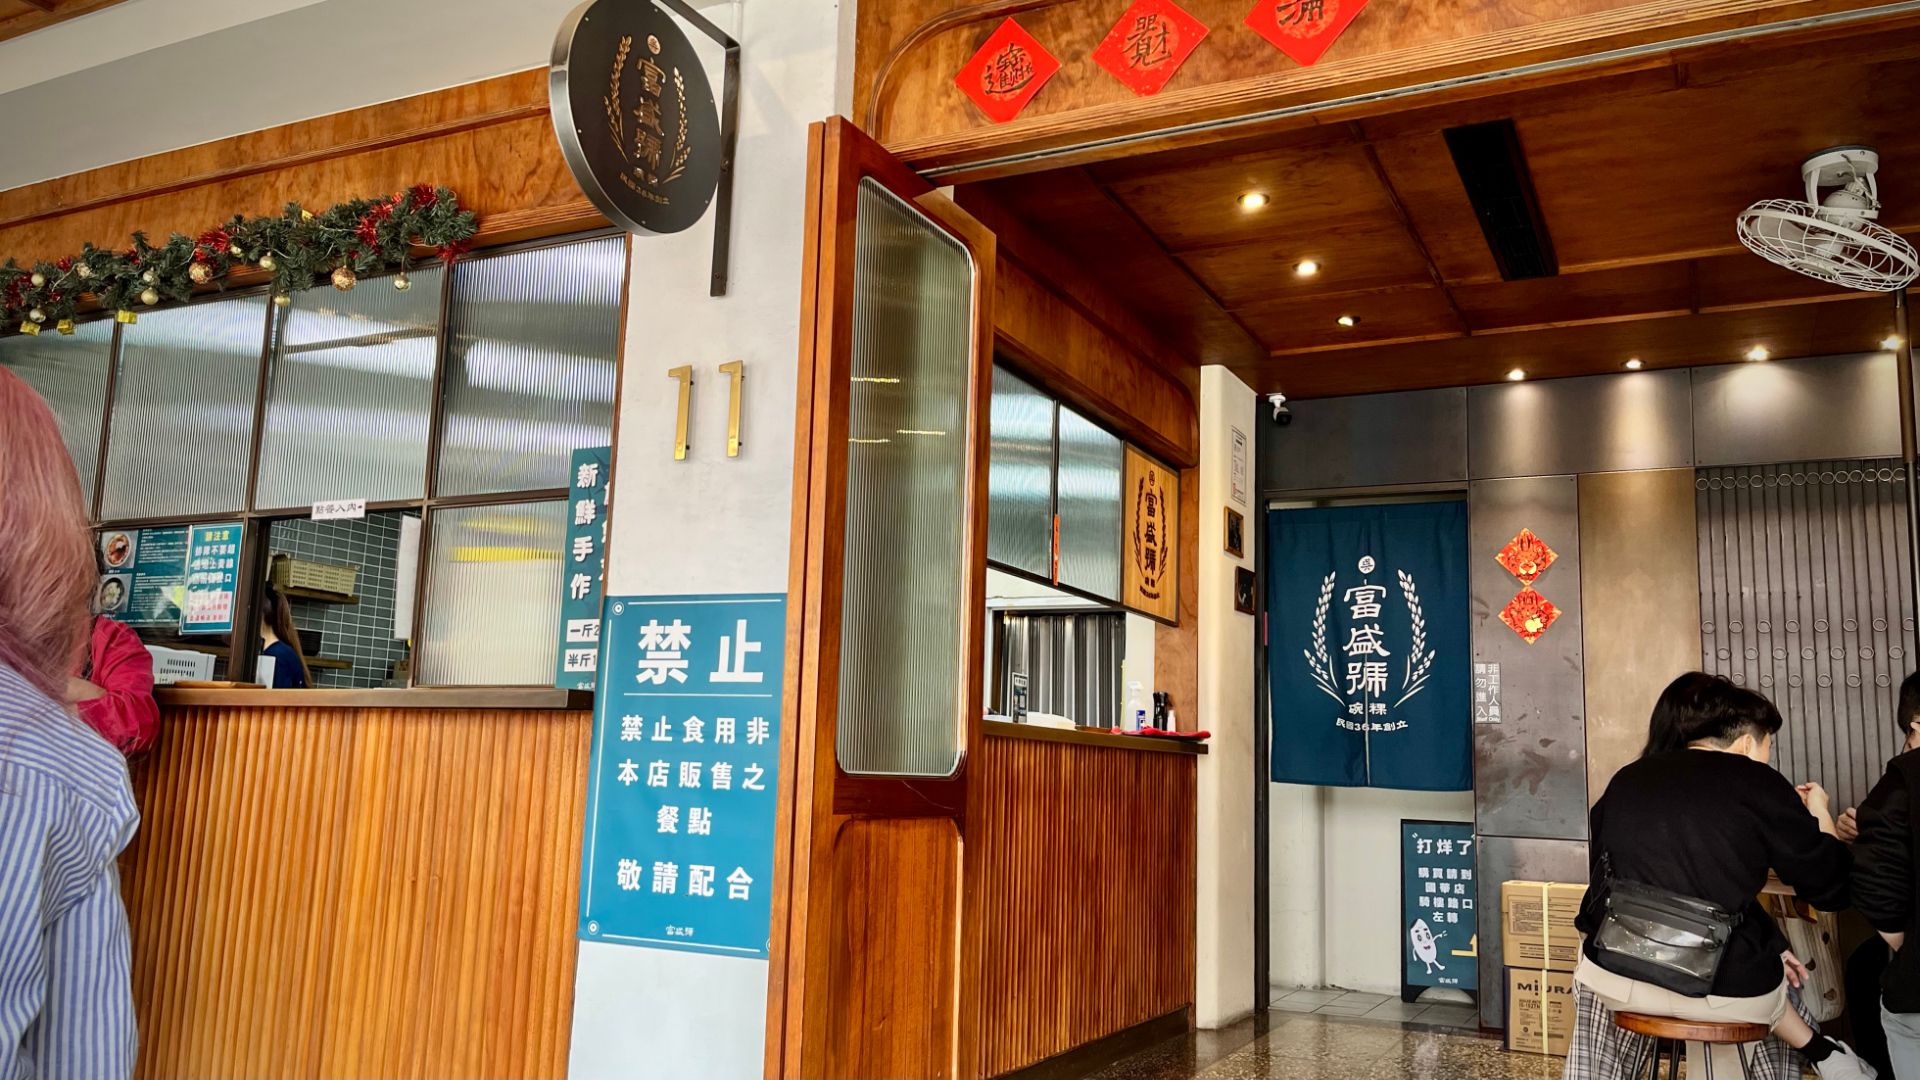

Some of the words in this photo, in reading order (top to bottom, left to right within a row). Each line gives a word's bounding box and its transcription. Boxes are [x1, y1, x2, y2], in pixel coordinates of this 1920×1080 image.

[570, 463, 598, 600] 新鮮手作
[635, 618, 764, 685] 禁止
[1342, 579, 1391, 698] 富盛號
[620, 714, 770, 745] 禁止食用非
[617, 758, 767, 791] 本店販售之
[656, 804, 713, 836] 餐點
[1416, 838, 1472, 856] 打烊了
[616, 858, 753, 900] 敬請配合
